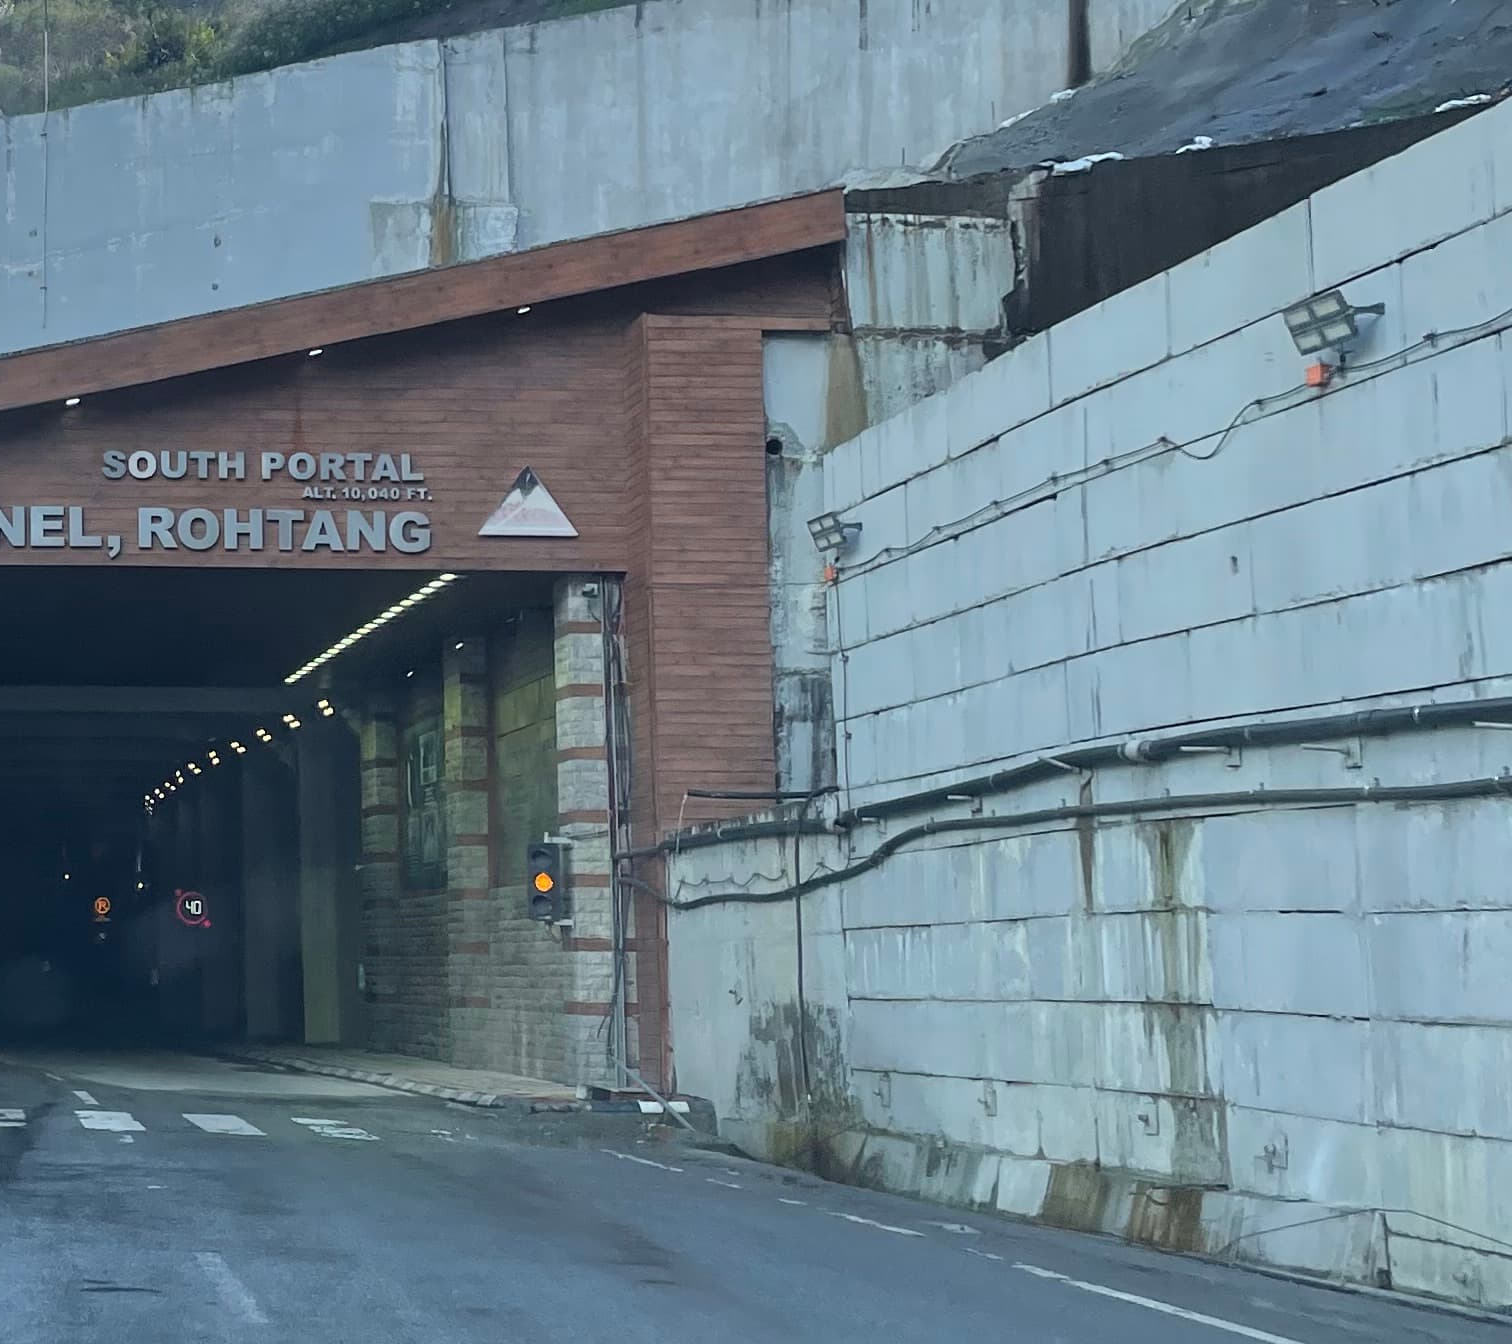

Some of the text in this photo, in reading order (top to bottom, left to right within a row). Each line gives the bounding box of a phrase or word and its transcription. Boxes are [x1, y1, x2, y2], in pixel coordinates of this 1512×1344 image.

[101, 450, 425, 482] SOUTH PORTAL
[302, 486, 433, 502] ALT. 10,040 FT.
[137, 507, 432, 554] ROHTANG
[185, 900, 202, 915] 40
